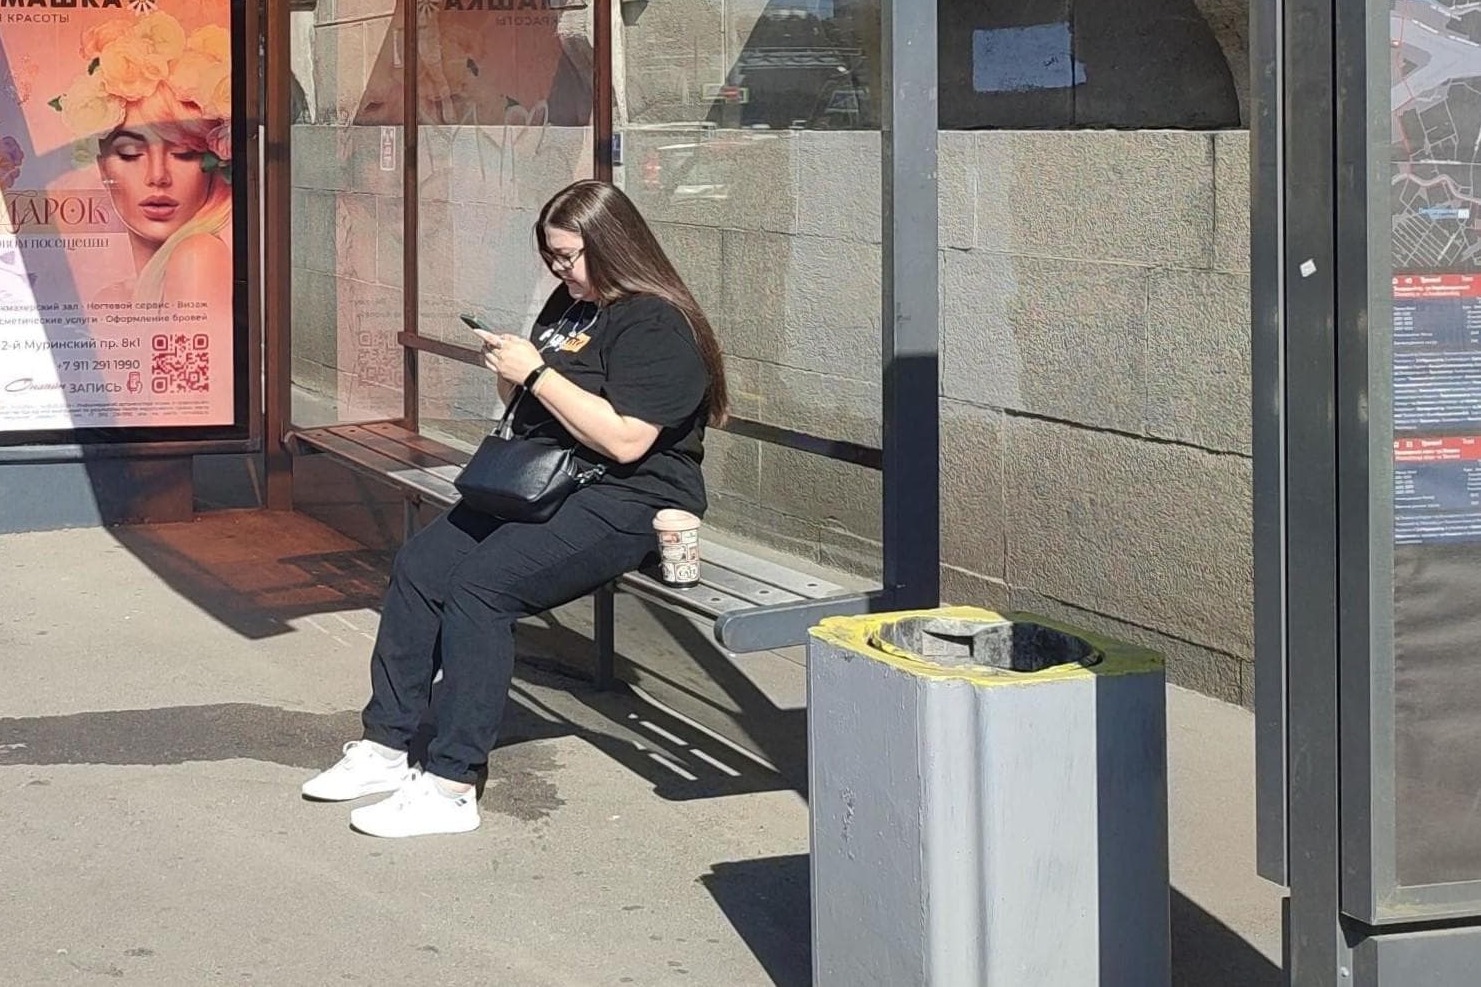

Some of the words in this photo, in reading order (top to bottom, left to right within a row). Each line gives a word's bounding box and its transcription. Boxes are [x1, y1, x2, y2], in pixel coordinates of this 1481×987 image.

[7, 13, 70, 23] КРАСОТЫ
[31, 236, 109, 251] посещении
[86, 302, 133, 311] Ногтевой
[135, 302, 170, 311] сервис
[65, 316, 98, 325] услуги
[105, 314, 170, 324] Оформление
[172, 313, 208, 322] бровей
[1, 340, 21, 351] 2-й
[24, 338, 97, 352] Муринский
[100, 340, 119, 350] пр.
[121, 337, 140, 348] 8к1
[56, 361, 70, 371] +7
[73, 360, 89, 371] 911
[93, 360, 111, 370] 291
[113, 359, 141, 370] 1990
[69, 382, 122, 394] ЗАПИСЬ
